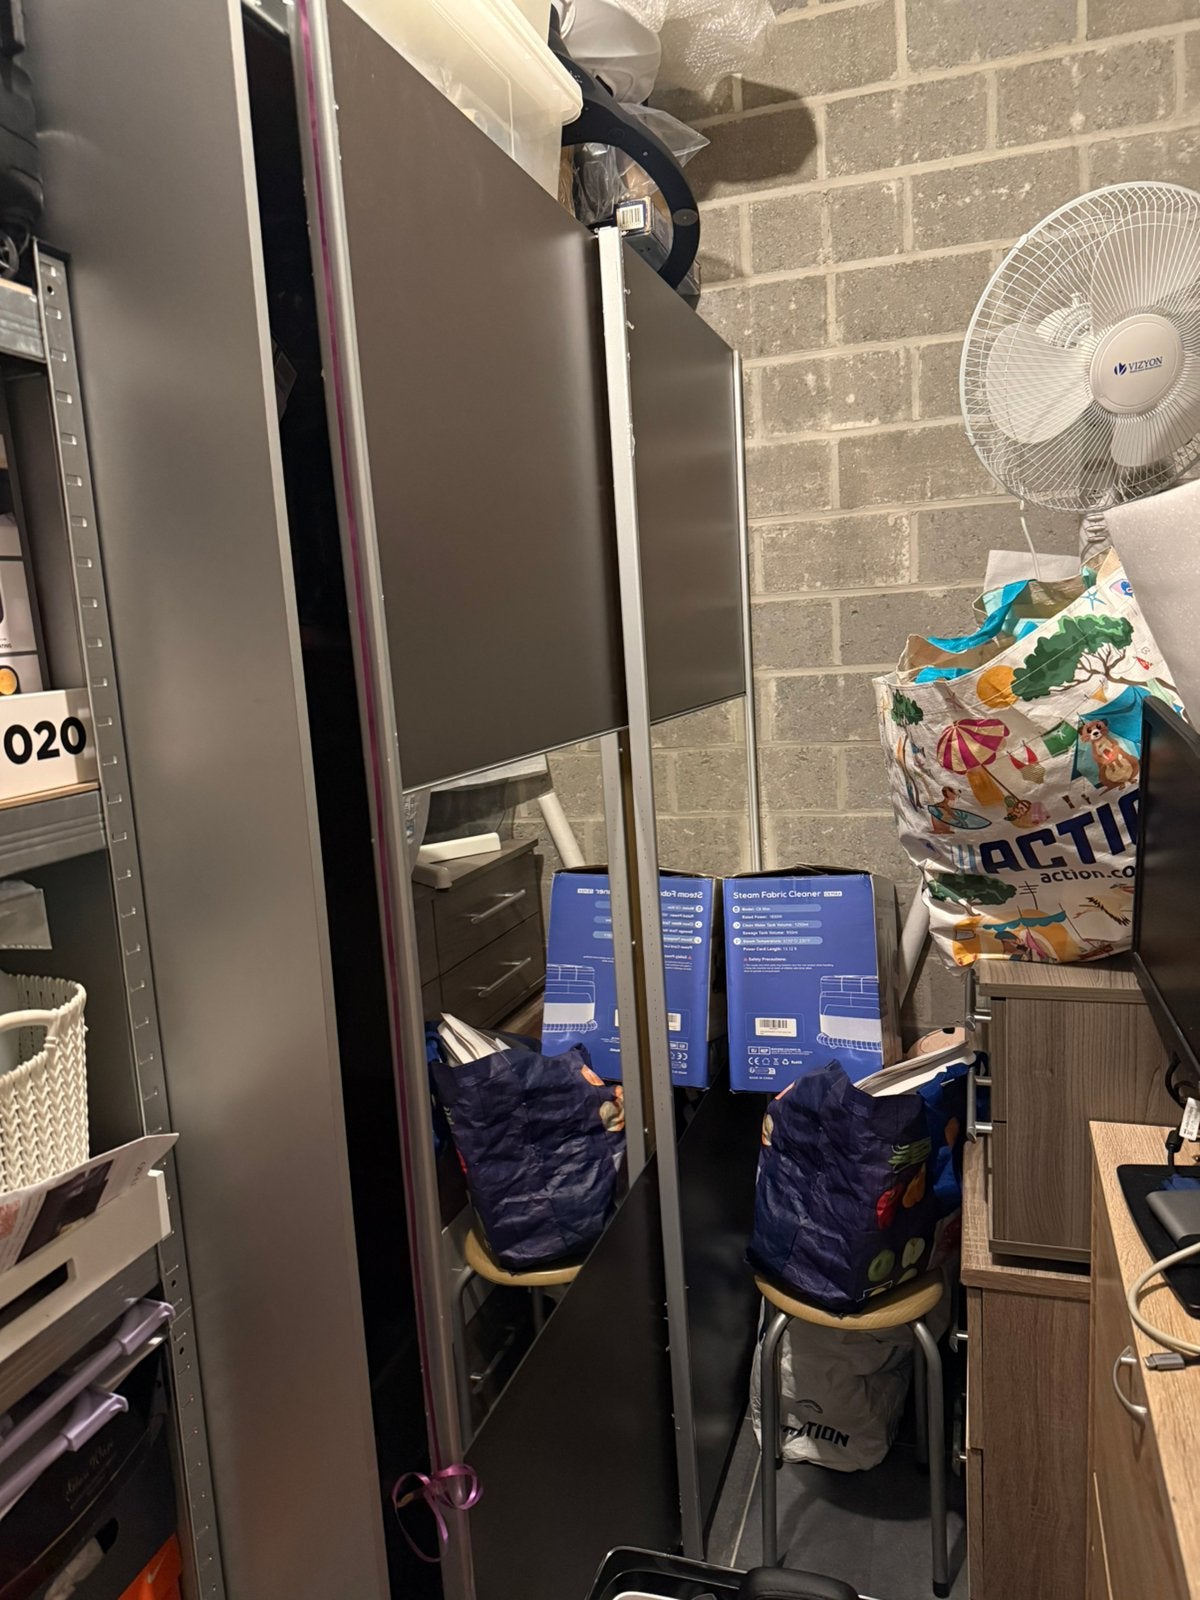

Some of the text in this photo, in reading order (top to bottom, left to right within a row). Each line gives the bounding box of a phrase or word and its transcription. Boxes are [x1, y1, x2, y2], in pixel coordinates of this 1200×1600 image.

[1128, 356, 1163, 371] VIZYON
[3, 716, 87, 765] 020
[979, 788, 1139, 875] ACTI
[1040, 865, 1136, 884] action.co
[733, 891, 760, 899] Steam
[761, 890, 788, 898] Fabric
[788, 890, 821, 898] Cleaner
